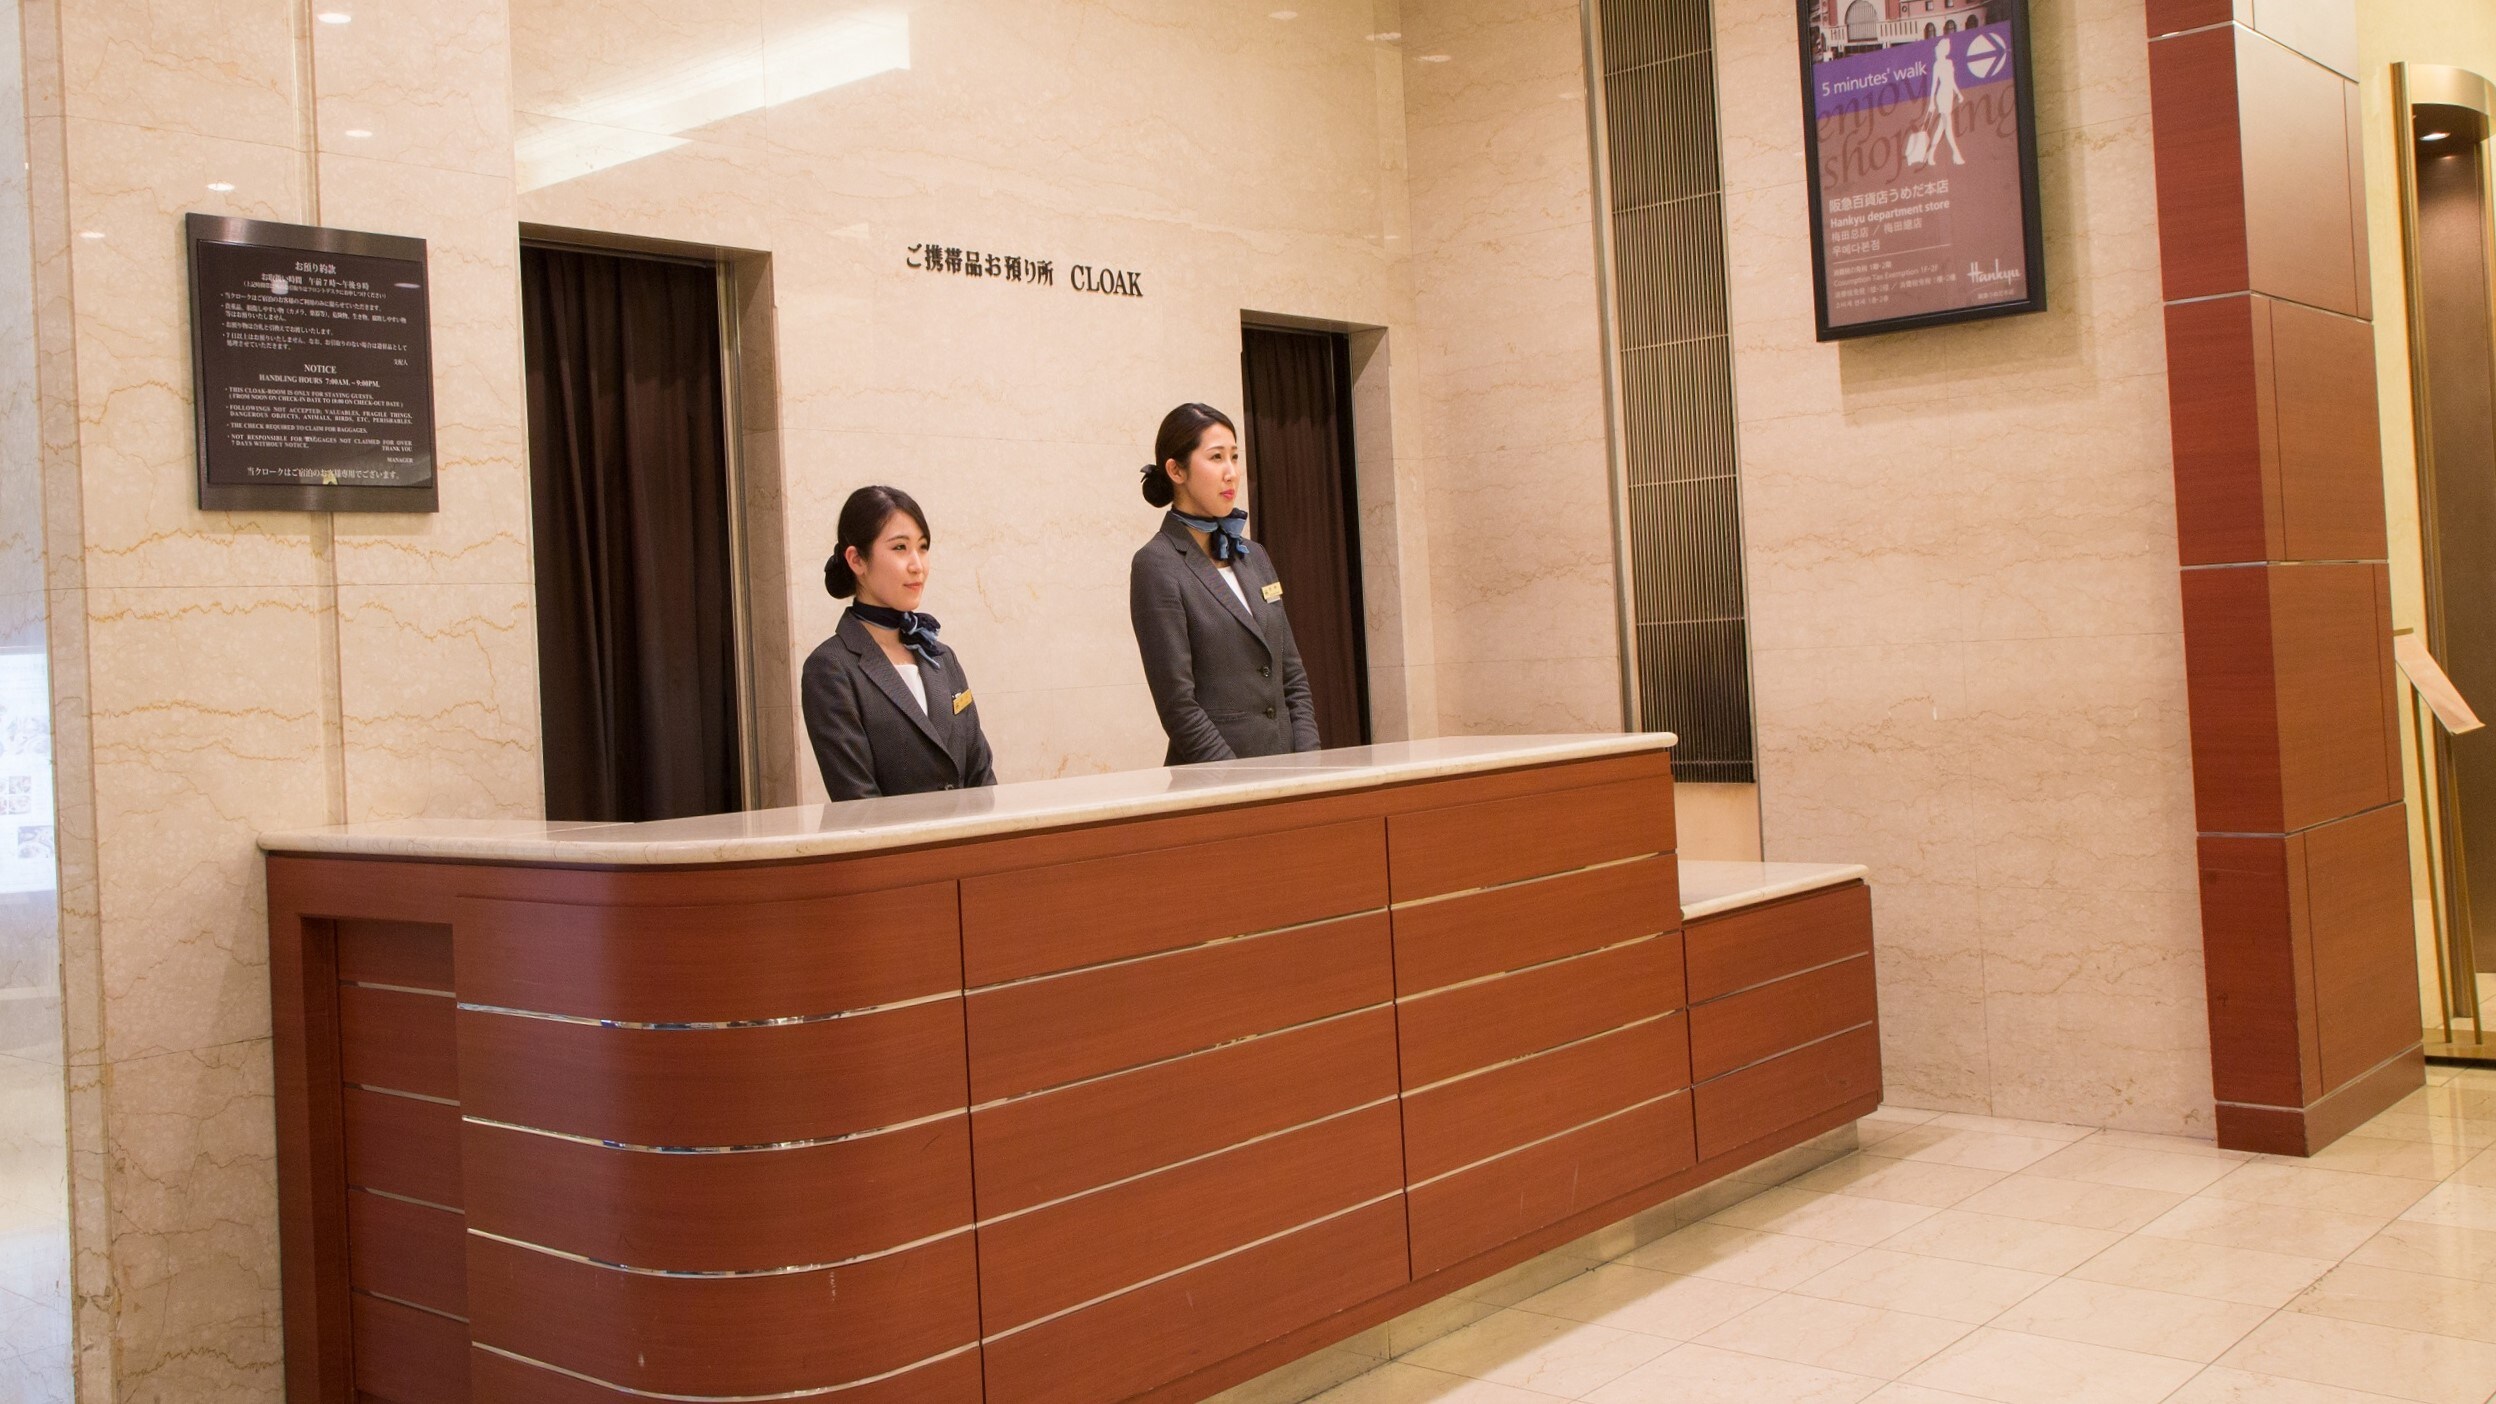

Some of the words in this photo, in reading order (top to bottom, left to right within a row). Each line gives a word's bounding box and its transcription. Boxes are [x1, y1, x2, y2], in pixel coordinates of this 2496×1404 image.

[1821, 81, 1830, 96] 5
[1893, 61, 1927, 80] walk
[1829, 179, 1949, 213] 阪急百貨店うめだ本店
[1830, 213, 1865, 230] Hankyu
[1867, 203, 1923, 222] department
[1924, 198, 1950, 212] store
[906, 243, 1054, 287] ご携帯品お預り所
[1070, 264, 1143, 297] CLOAK
[1967, 258, 2020, 285] Hankyu
[303, 364, 337, 373] NOTICE
[259, 373, 297, 382] HANDLING
[298, 375, 322, 384] HOURS
[244, 387, 285, 395] CLOAK-ROOM
[229, 404, 270, 412] FOLLOWINGS
[353, 398, 384, 406] CHECK-OUT
